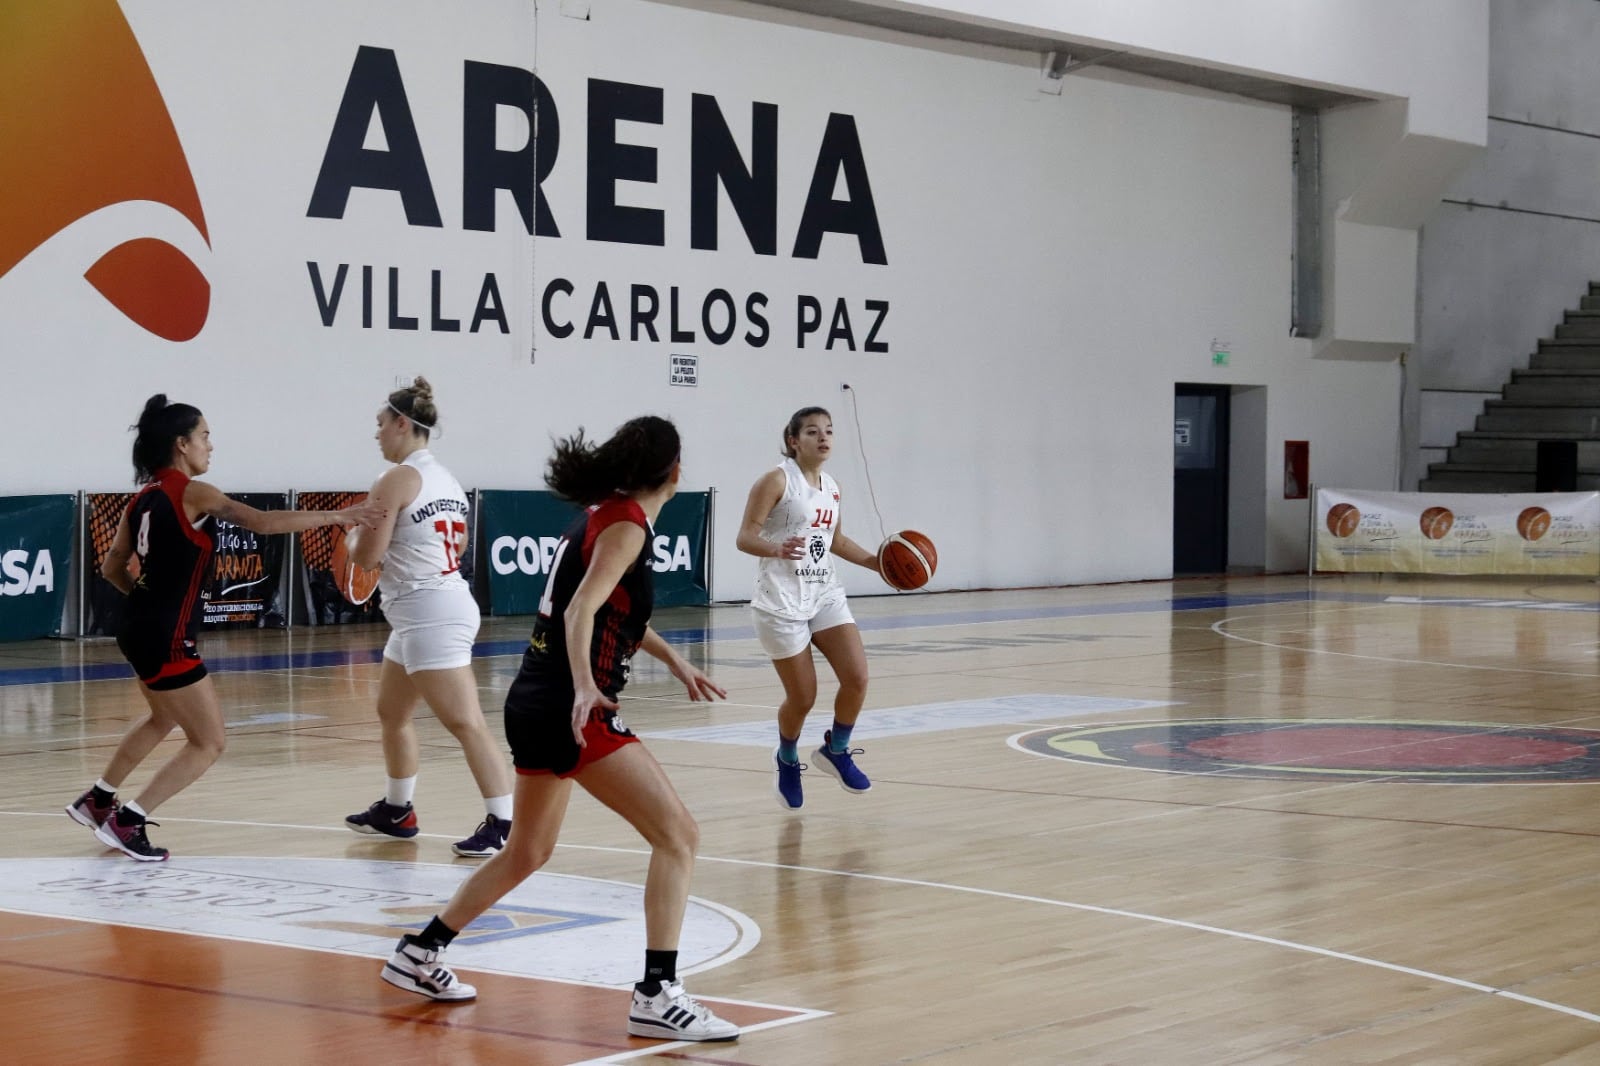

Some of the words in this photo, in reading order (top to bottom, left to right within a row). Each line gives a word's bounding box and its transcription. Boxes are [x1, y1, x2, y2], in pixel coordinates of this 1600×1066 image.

[307, 46, 888, 266] ARENA
[307, 262, 510, 334] VILLA
[541, 278, 770, 348] CARLOS
[797, 295, 889, 353] PAZ
[811, 508, 832, 529] 14
